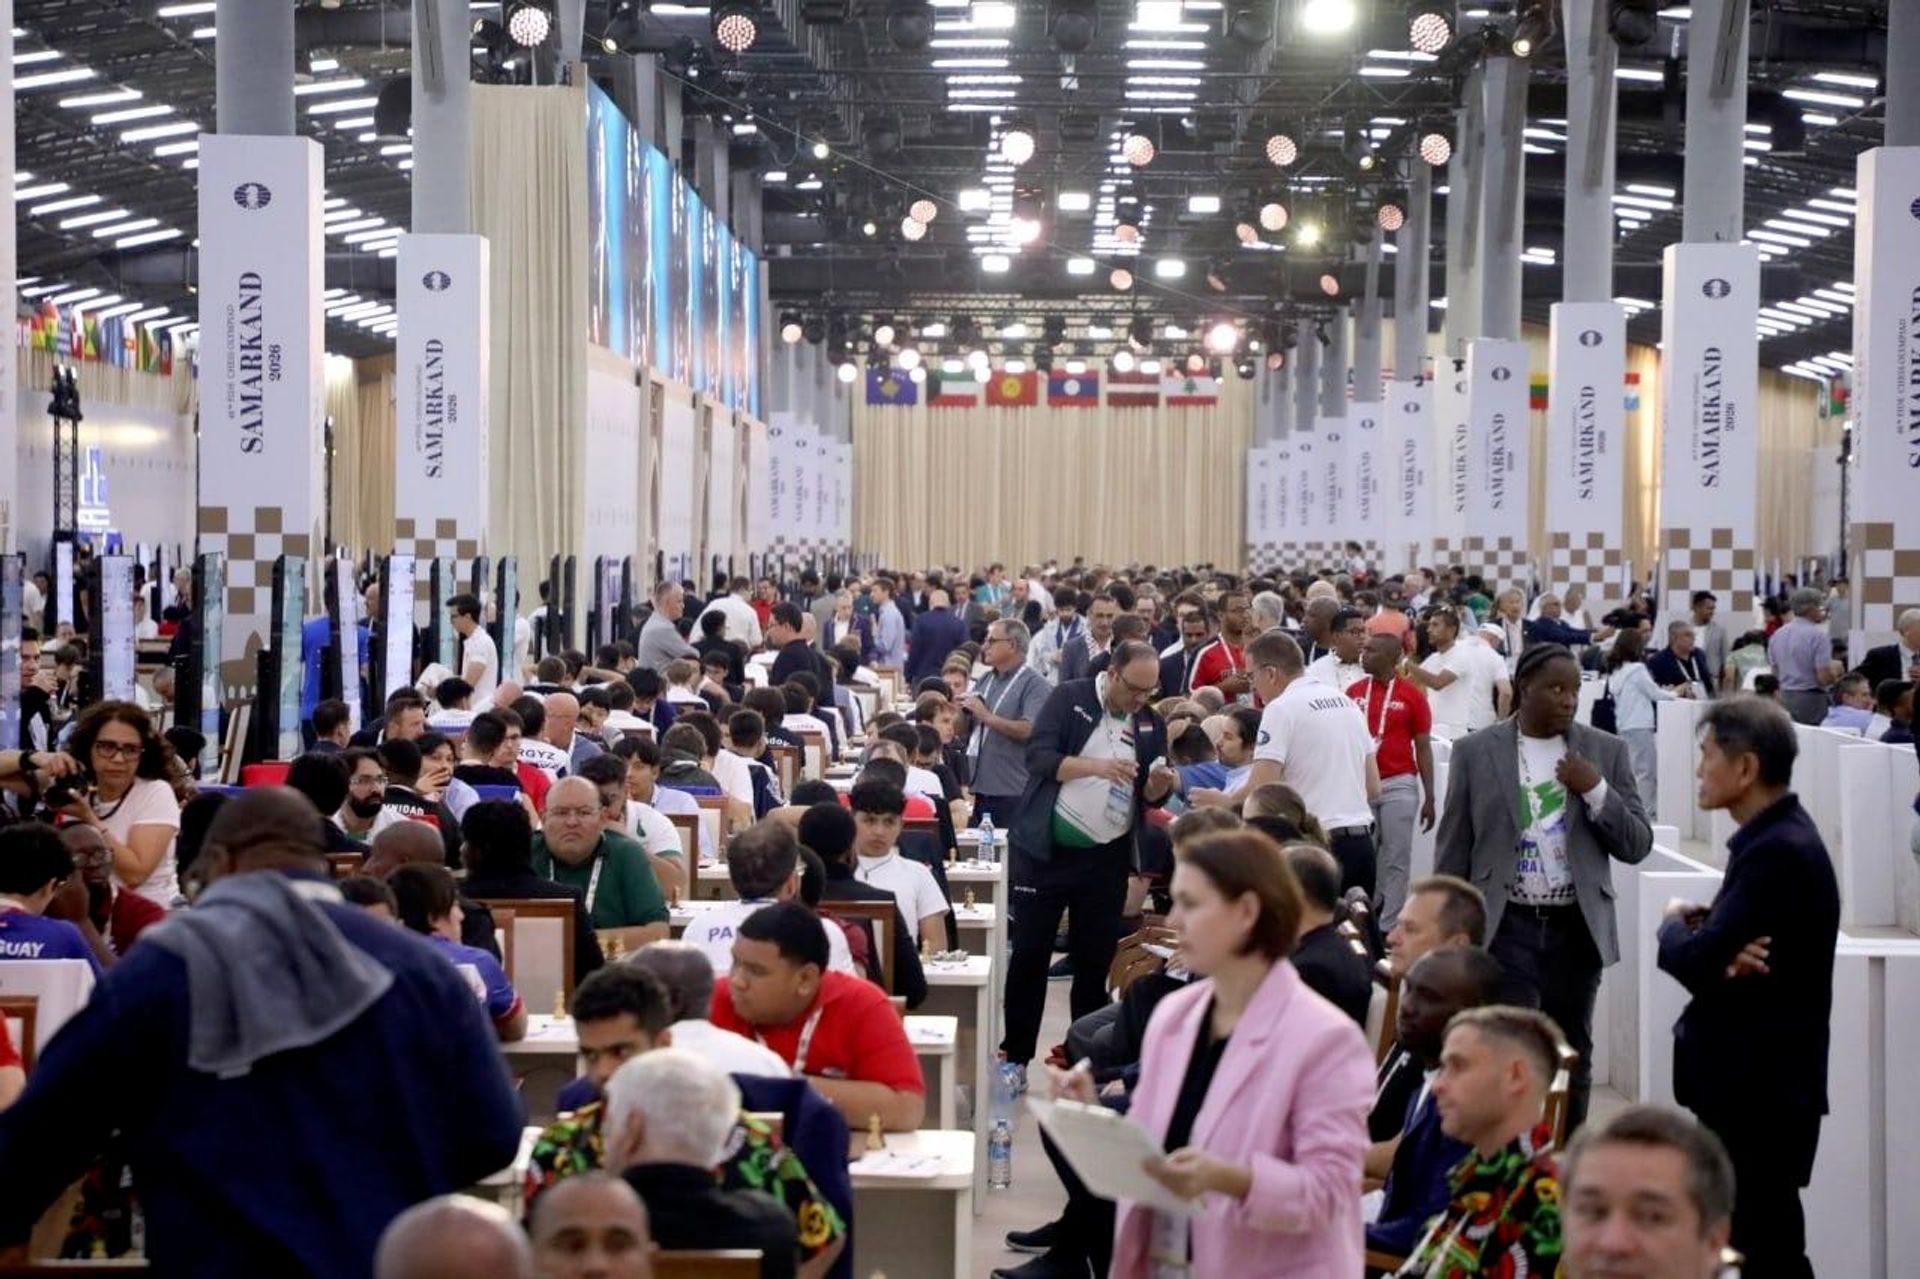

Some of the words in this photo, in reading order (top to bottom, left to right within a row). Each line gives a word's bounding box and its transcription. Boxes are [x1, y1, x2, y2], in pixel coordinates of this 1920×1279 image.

[239, 272, 263, 454] SAMARKAND
[269, 344, 281, 381] 2026
[425, 339, 443, 478] SAMARKAND
[447, 395, 457, 423] 2026
[1455, 424, 1467, 512] SAMARKAND
[1491, 414, 1505, 509] SAMARKAND
[1580, 386, 1595, 499] SAMARKAND
[1701, 347, 1722, 487] SAMARKAND
